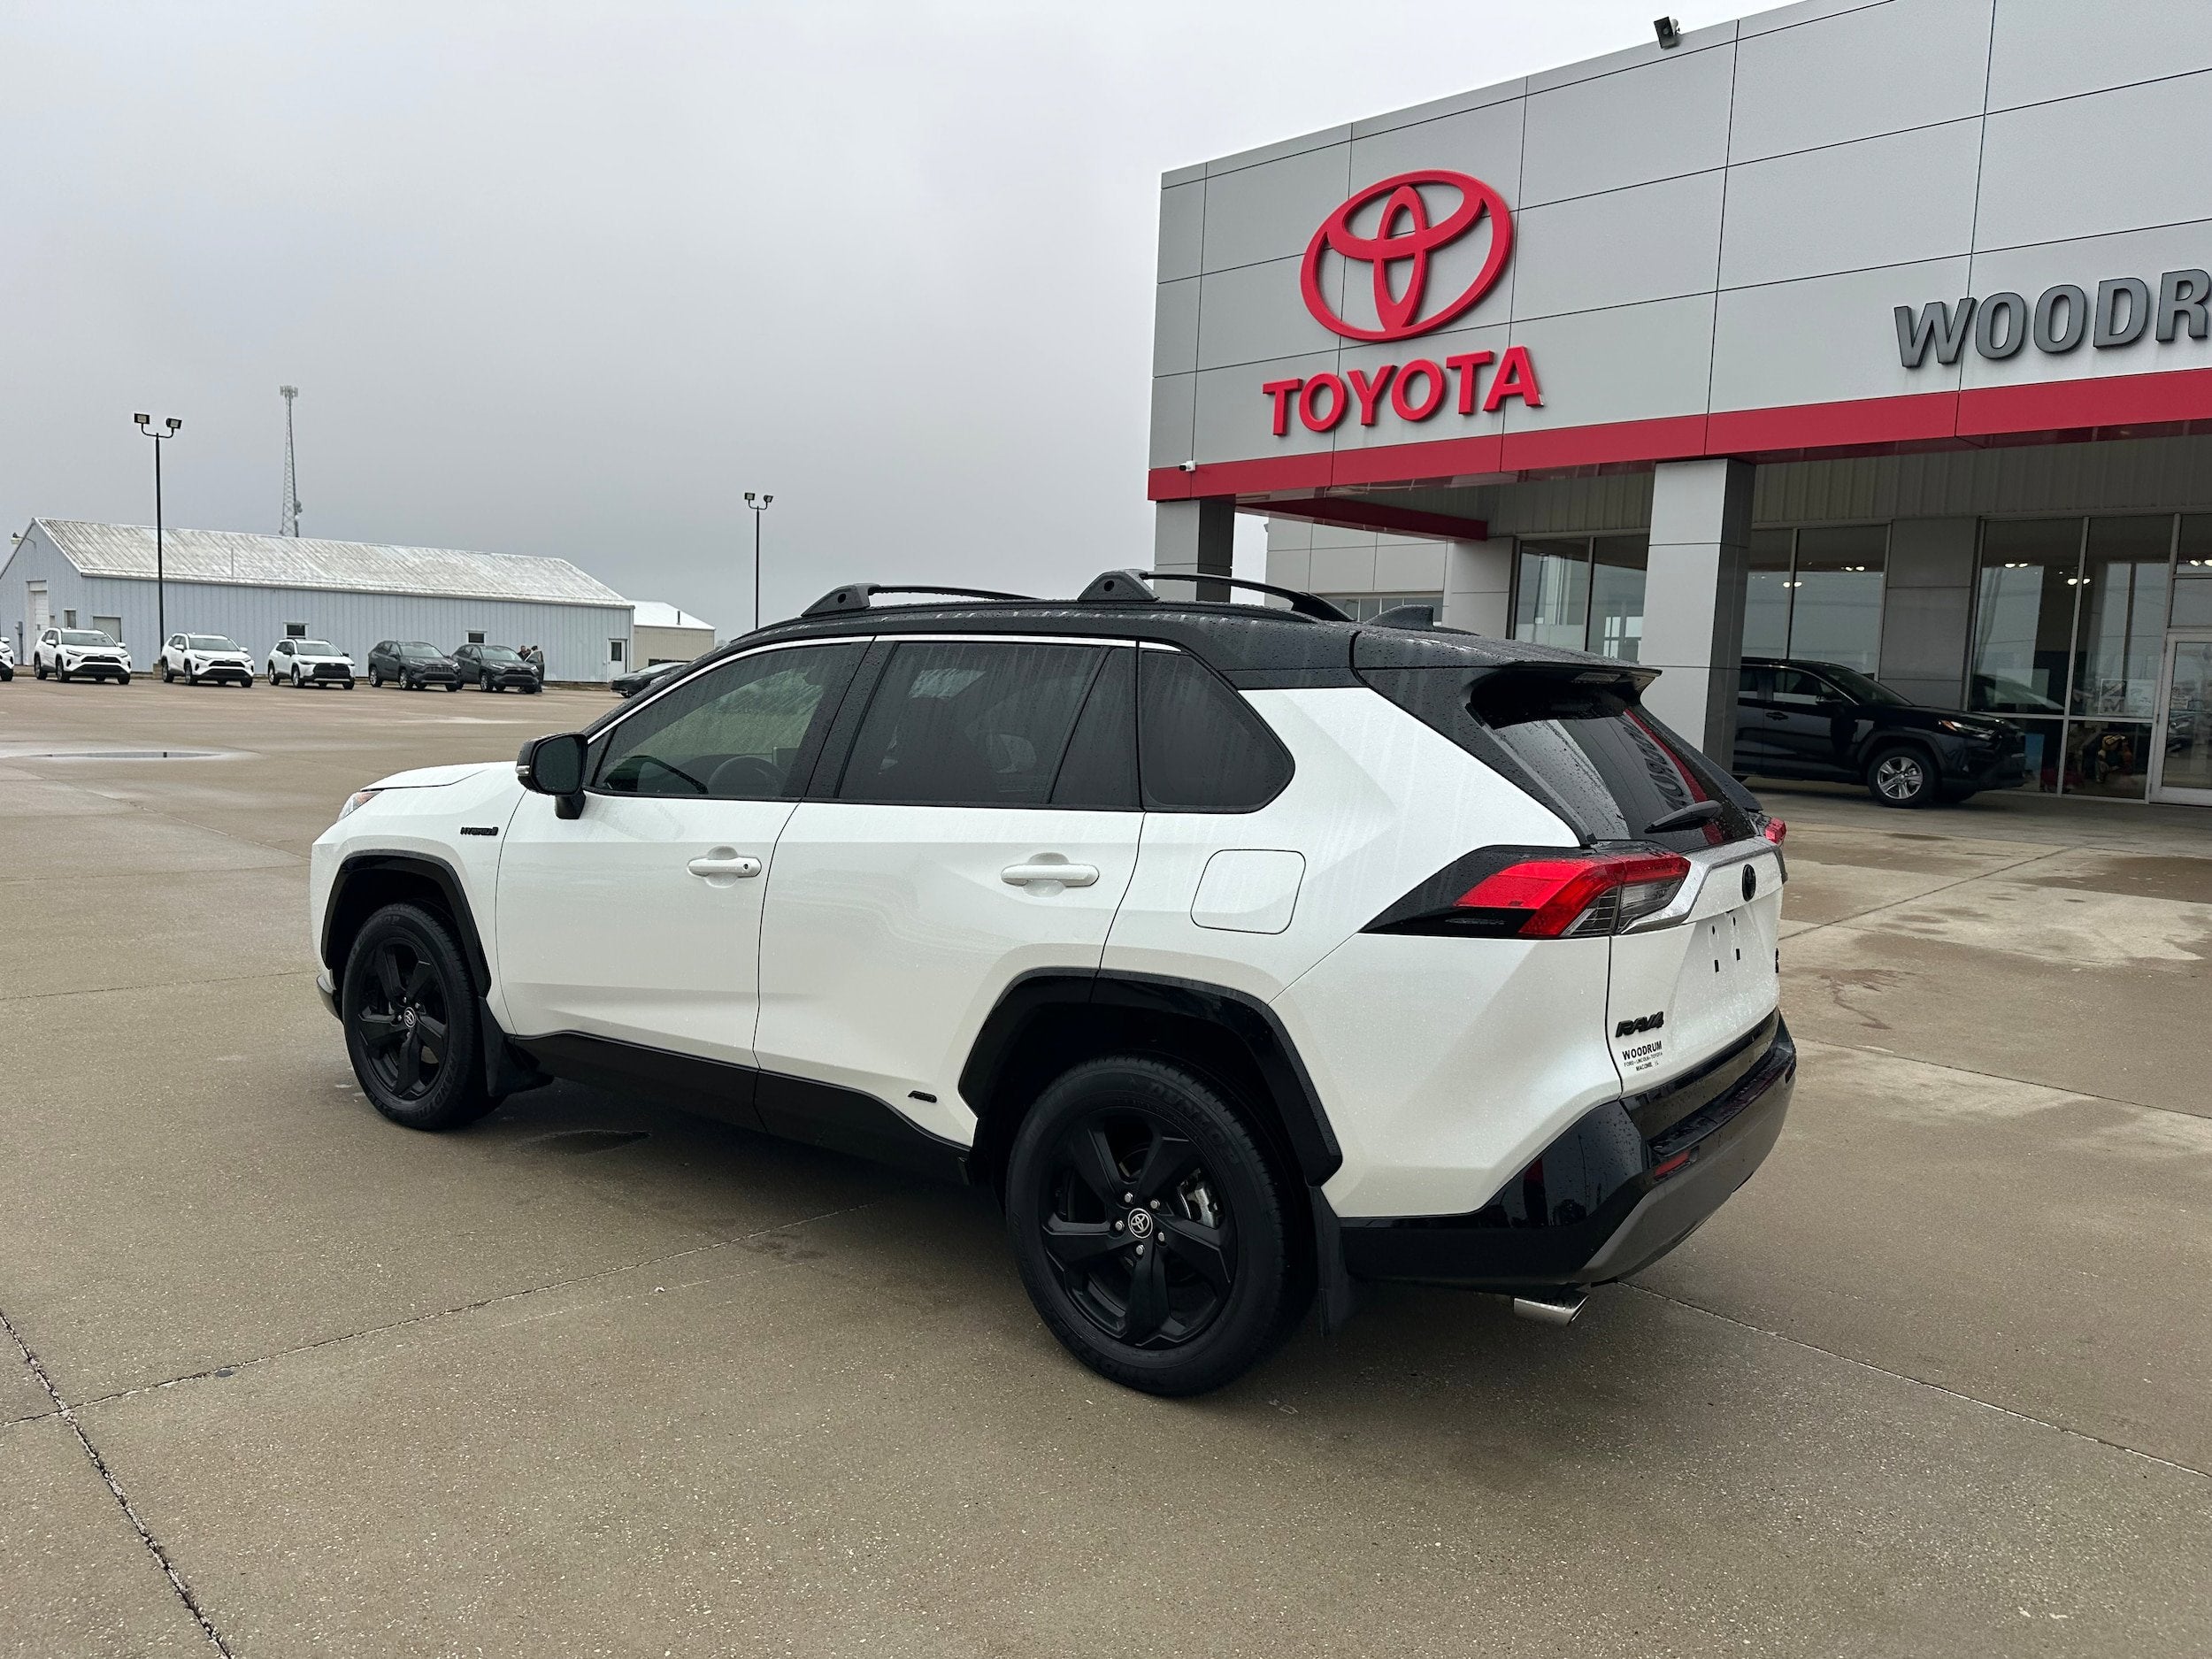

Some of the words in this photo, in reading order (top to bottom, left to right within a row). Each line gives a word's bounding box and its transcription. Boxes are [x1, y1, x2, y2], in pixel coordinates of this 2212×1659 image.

[1893, 268, 2212, 368] WOODR
[1263, 346, 1543, 437] TOYOTA
[1615, 1011, 1664, 1038] RAV4
[1622, 1041, 1663, 1061] WOODRUM
